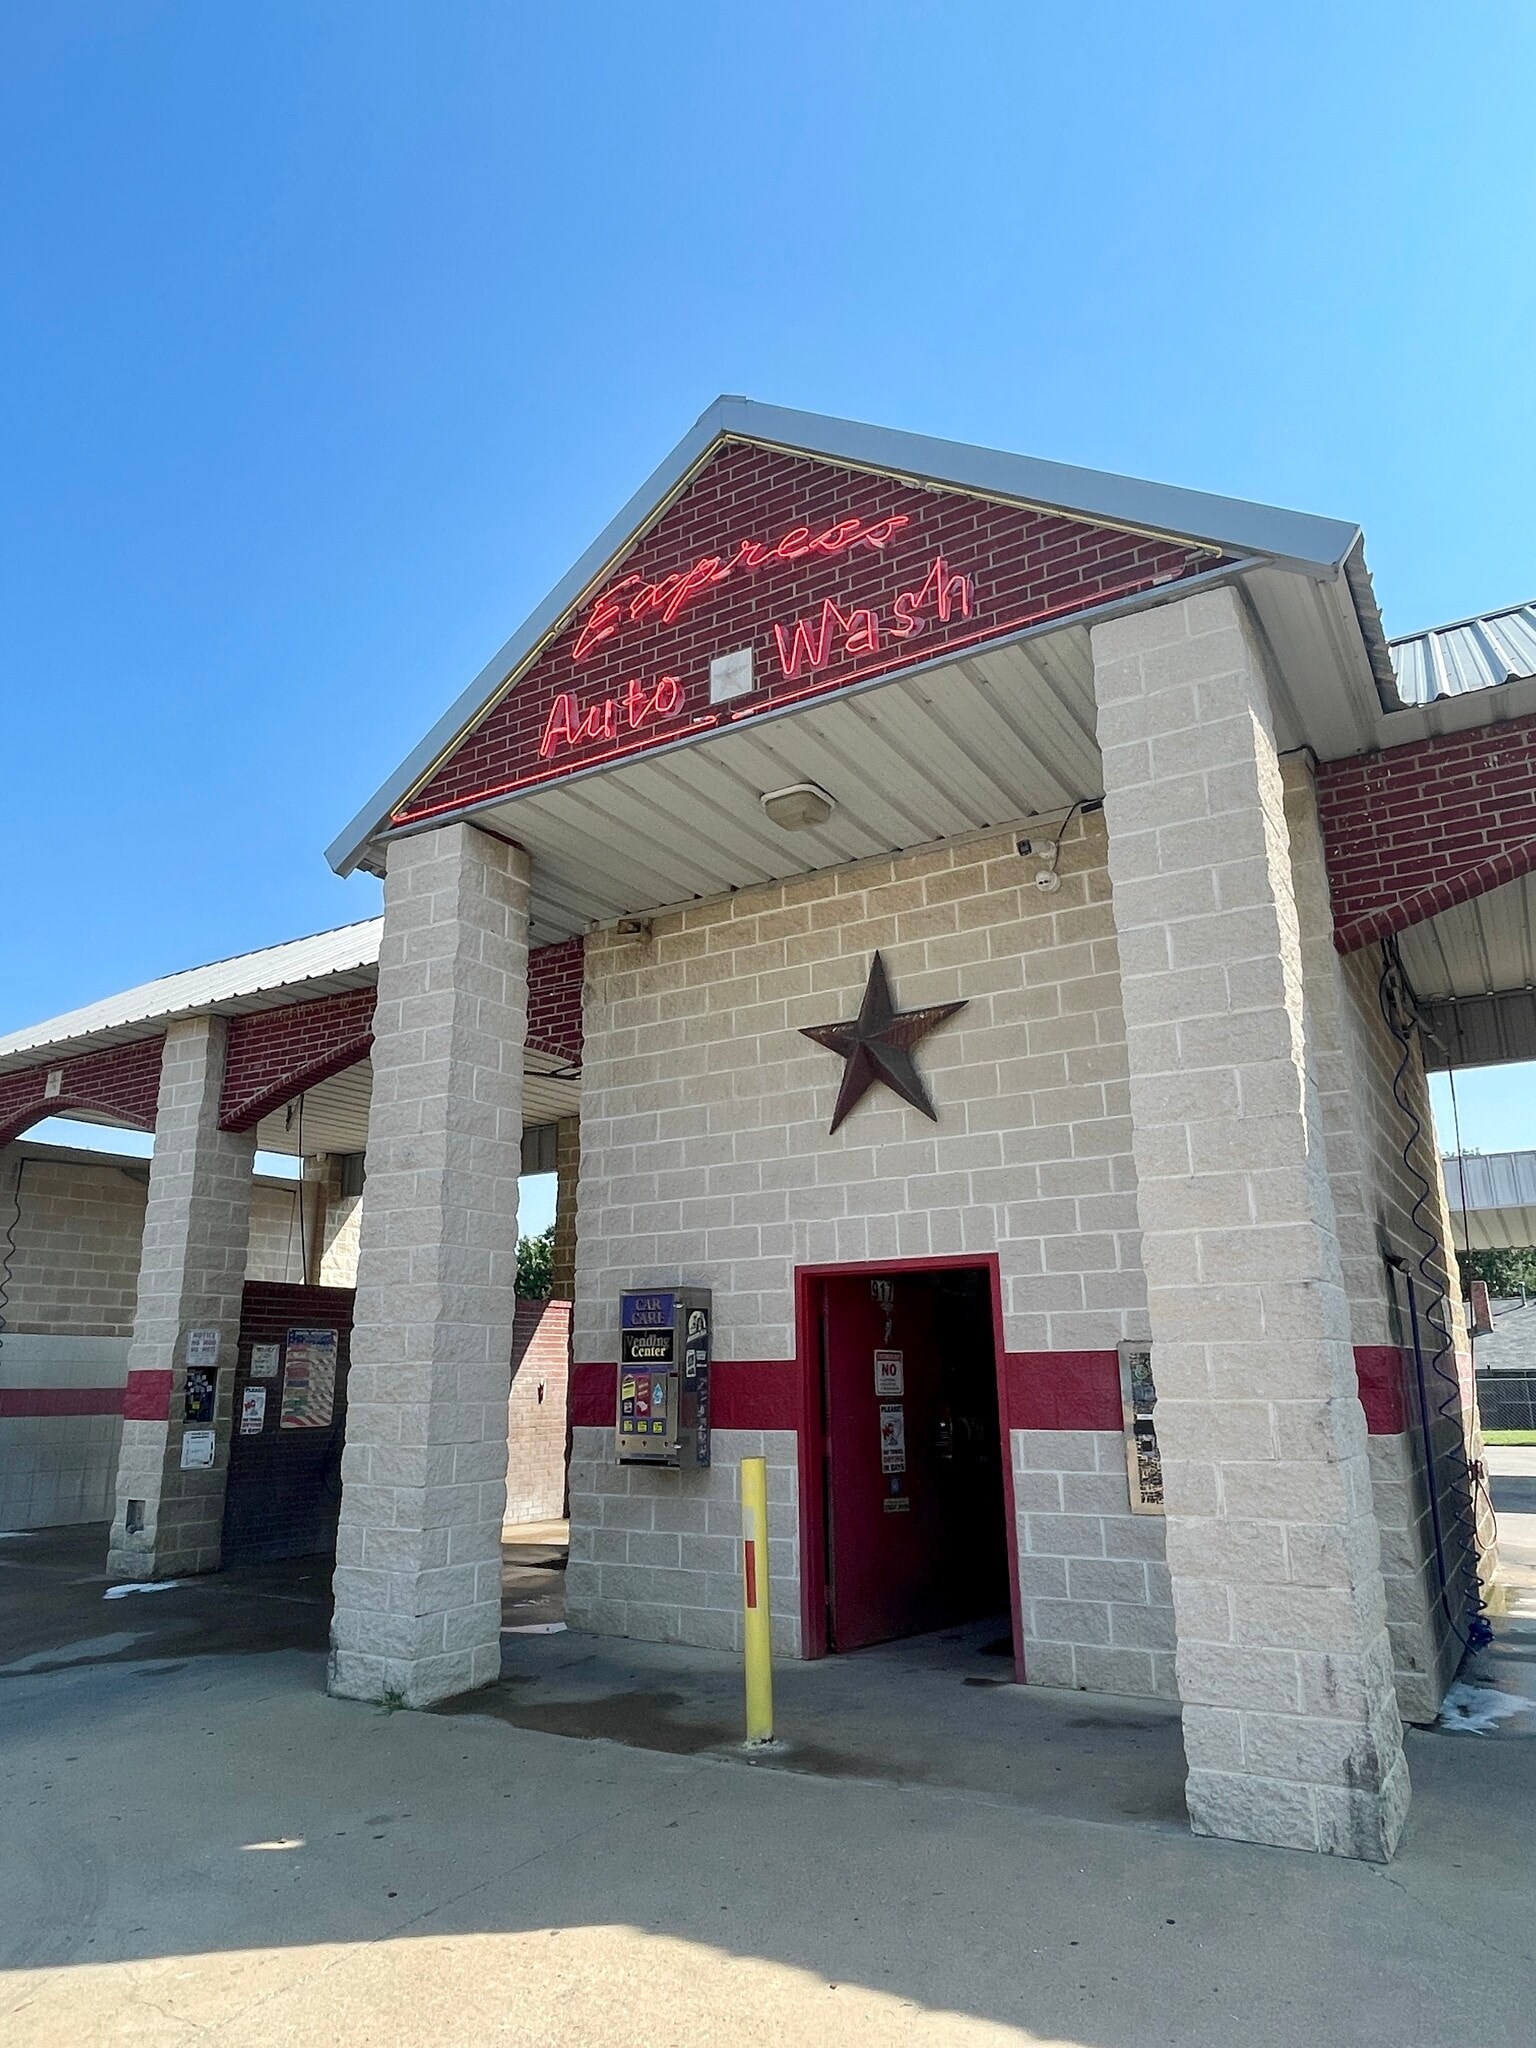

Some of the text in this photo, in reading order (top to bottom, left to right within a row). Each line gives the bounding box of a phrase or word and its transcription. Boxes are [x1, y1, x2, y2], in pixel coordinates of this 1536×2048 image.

[572, 514, 909, 660] Express
[540, 556, 972, 757] Auto Wash
[635, 1298, 662, 1311] CAR
[632, 1311, 666, 1325] CARE
[625, 1333, 671, 1350] Vending
[631, 1345, 666, 1357] Center
[882, 1363, 897, 1376] NO
